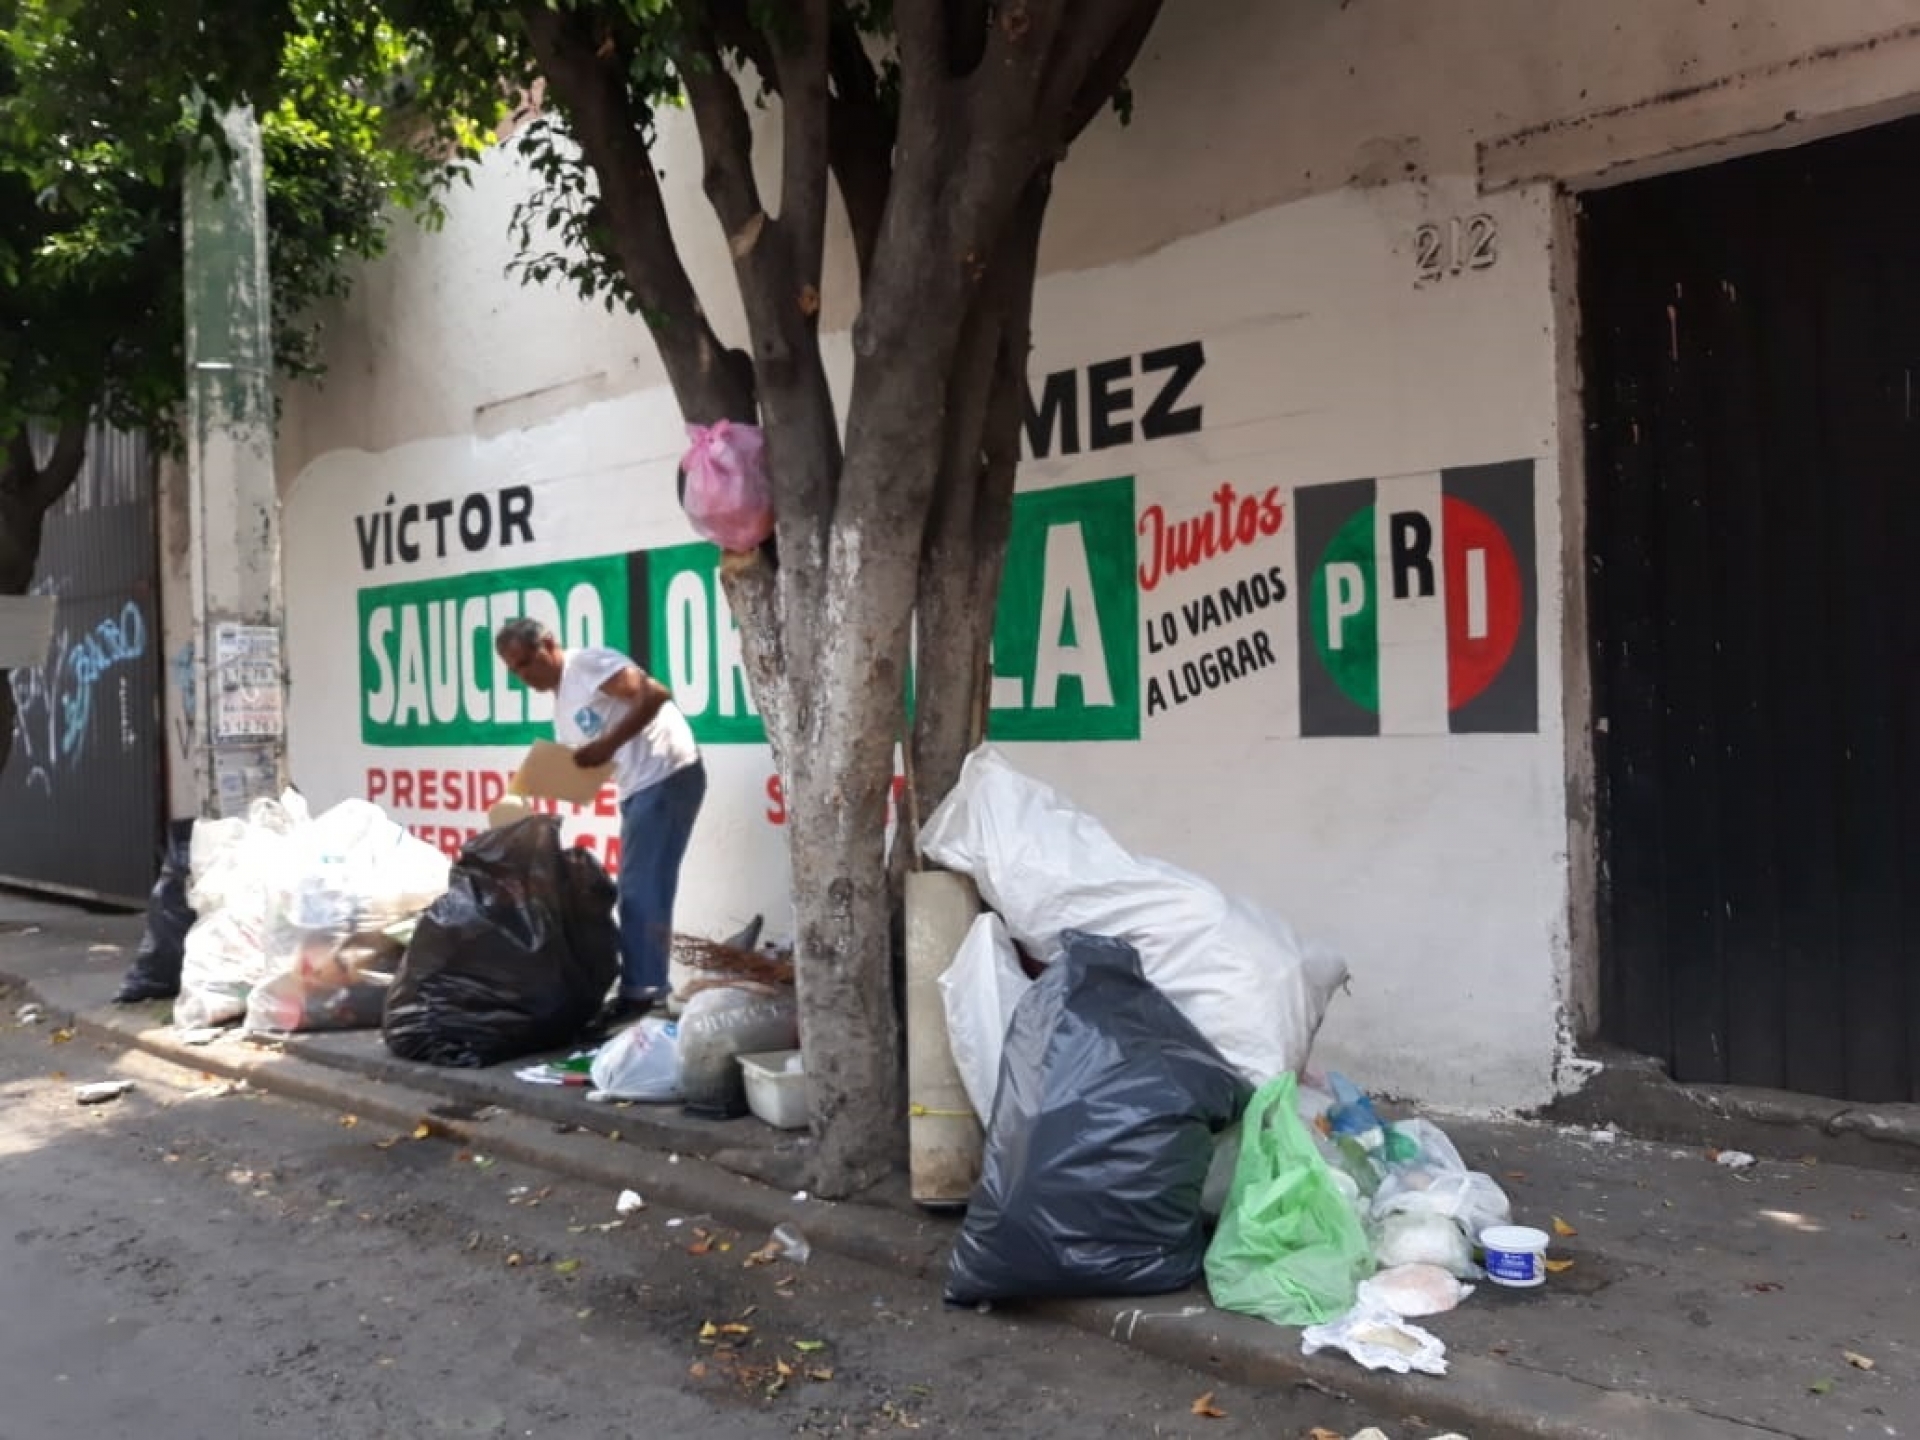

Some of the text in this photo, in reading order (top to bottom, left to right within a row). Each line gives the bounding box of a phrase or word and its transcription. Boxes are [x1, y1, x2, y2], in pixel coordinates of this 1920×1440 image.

[1415, 214, 1498, 280] 212
[355, 484, 535, 570] VÍCTOR
[1138, 482, 1285, 592] Juntos
[1147, 566, 1288, 654] LO VAMOS
[1325, 511, 1488, 650] PRI
[1147, 630, 1276, 717] A LOGRAR
[367, 768, 618, 817] PRESIDE
